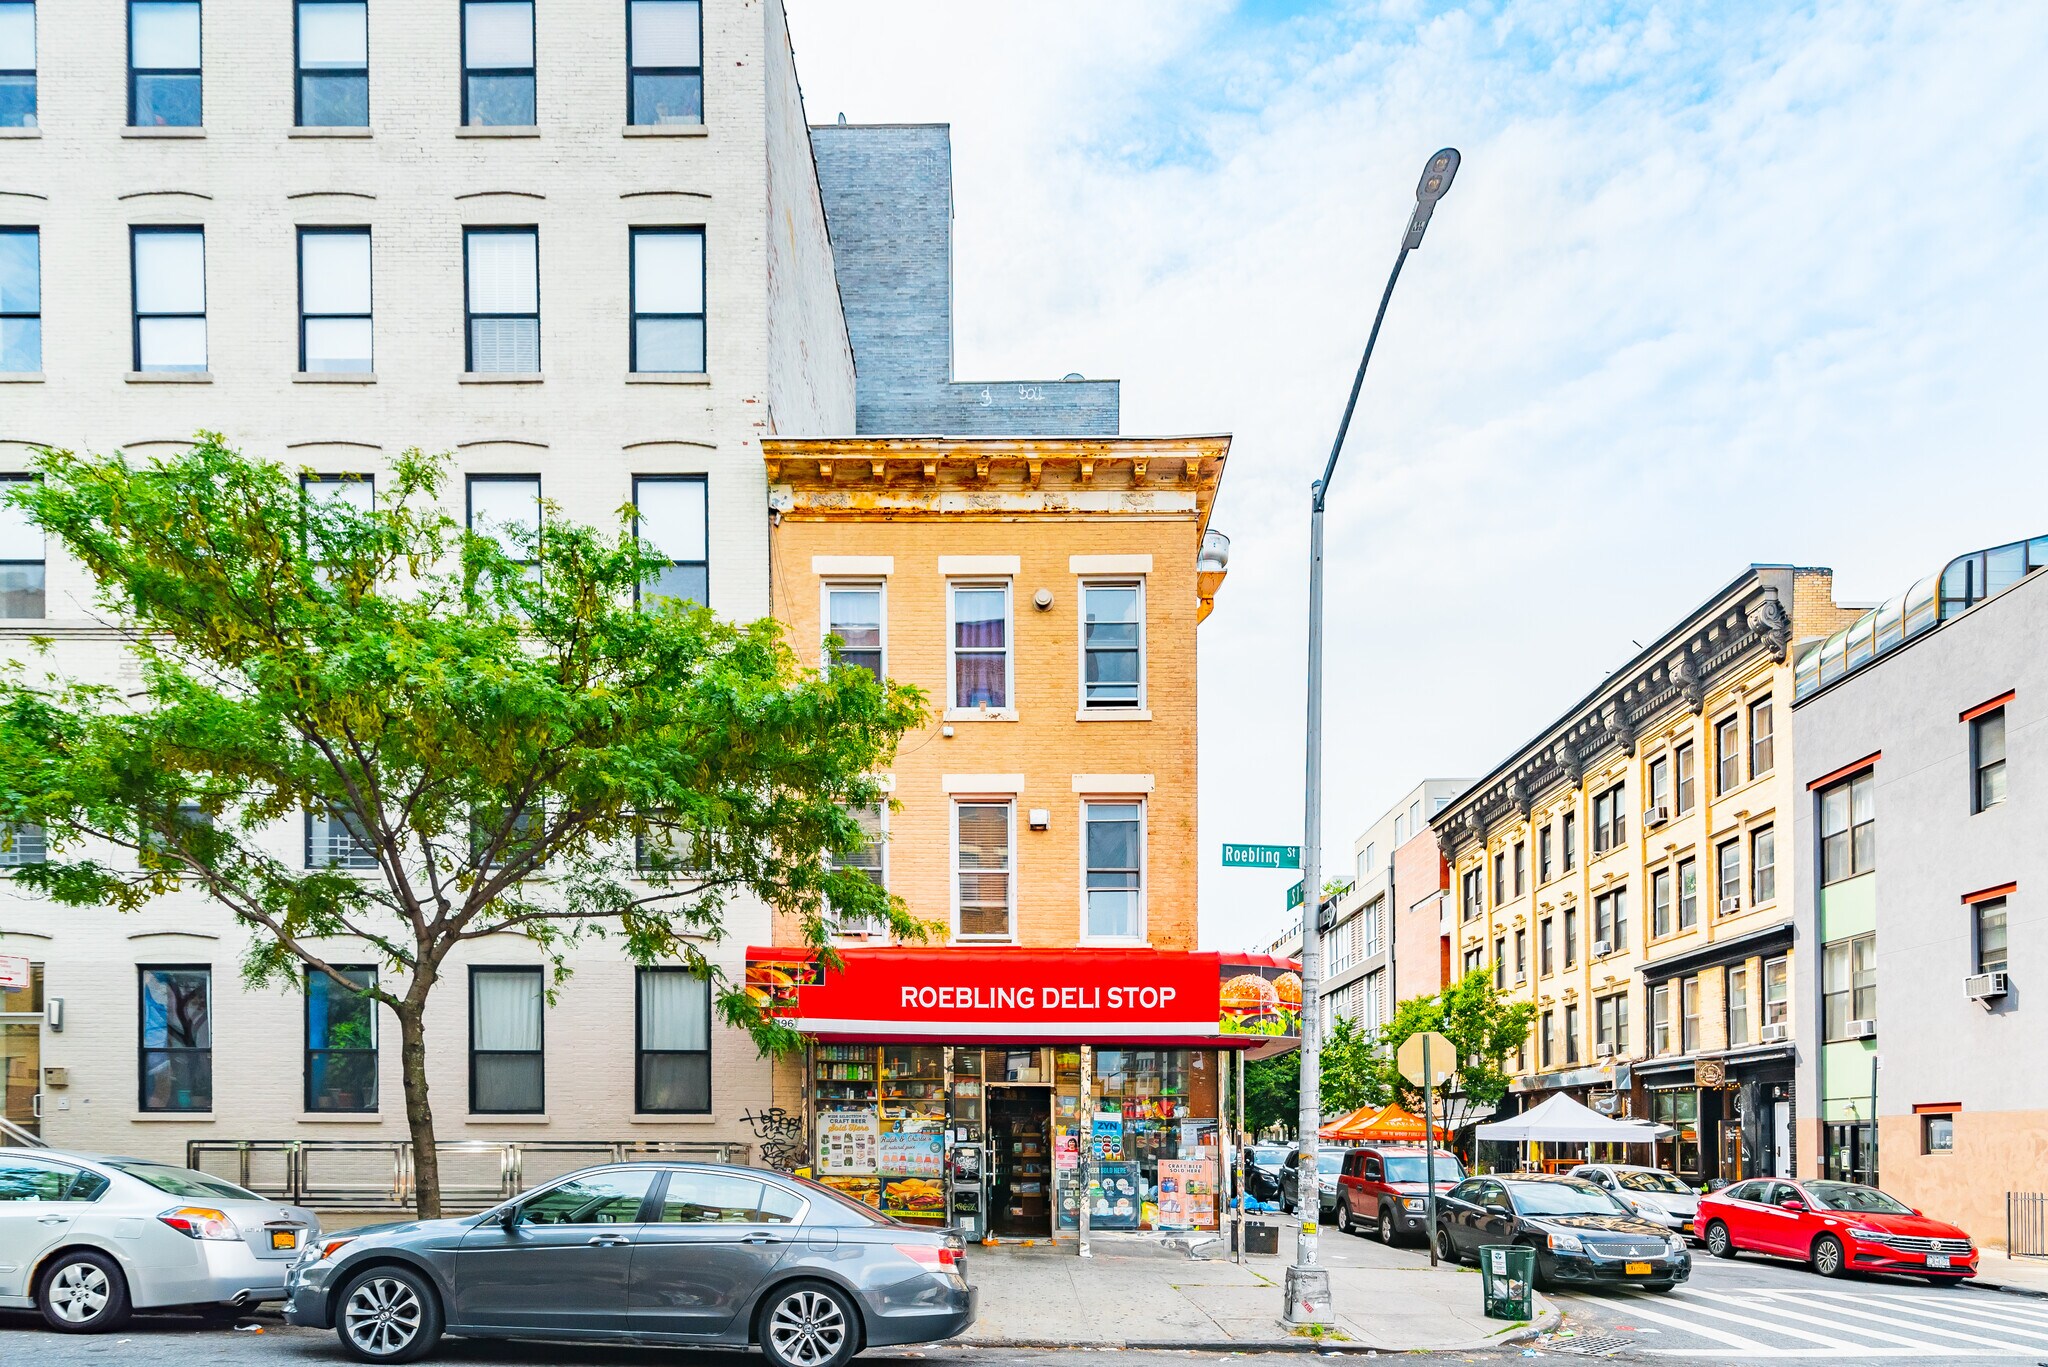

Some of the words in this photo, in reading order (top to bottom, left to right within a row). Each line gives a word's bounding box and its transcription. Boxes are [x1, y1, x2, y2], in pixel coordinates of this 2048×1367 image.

[1225, 845, 1280, 868] Roebling
[1287, 847, 1296, 858] St
[901, 986, 1035, 1009] ROEBLING
[1042, 986, 1100, 1009] DELI
[1106, 986, 1177, 1009] STOP
[828, 1124, 847, 1132] Sold
[849, 1124, 870, 1132] Here
[1097, 1121, 1118, 1130] ZYN
